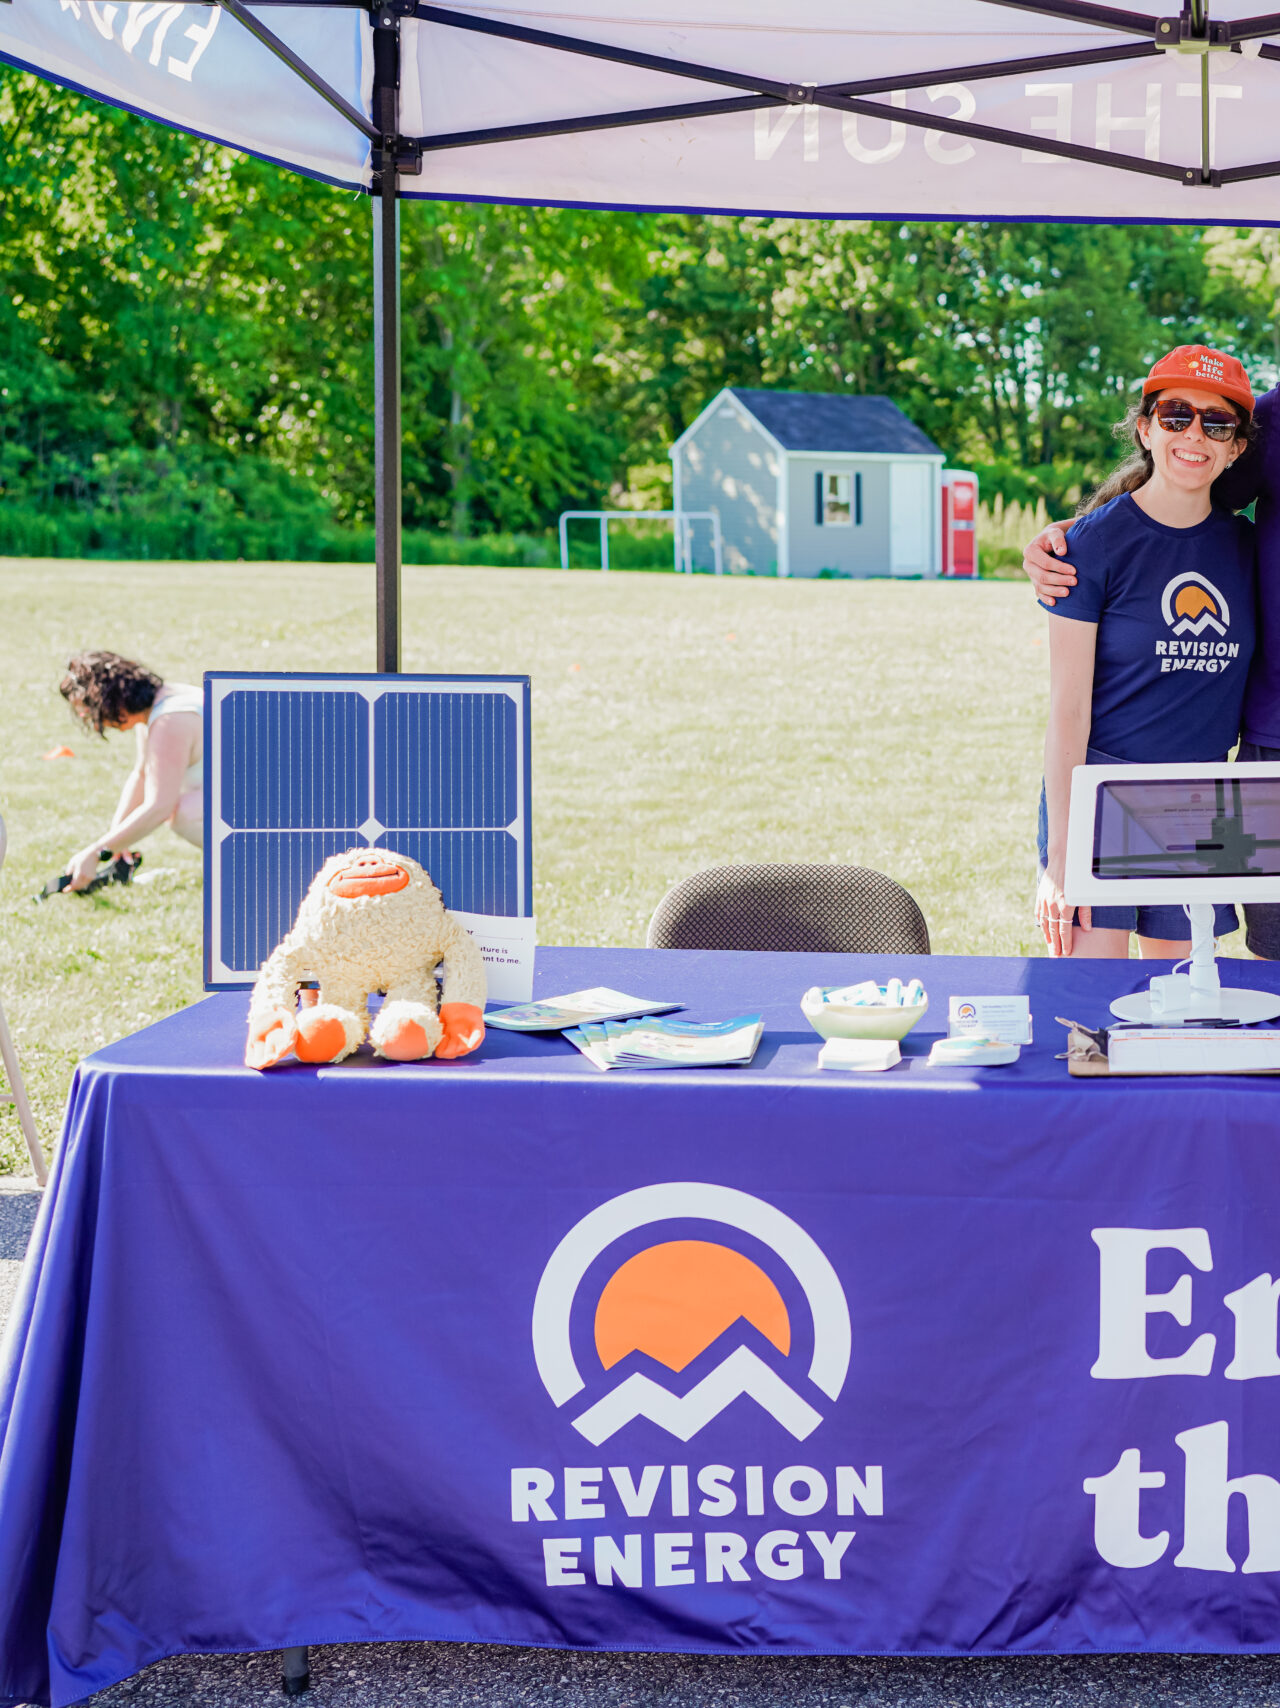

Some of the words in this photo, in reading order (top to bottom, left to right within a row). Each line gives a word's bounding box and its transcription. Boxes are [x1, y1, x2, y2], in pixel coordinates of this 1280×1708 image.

[1200, 354, 1224, 367] Make
[1195, 369, 1225, 383] better.
[1202, 363, 1223, 376] life
[1155, 640, 1240, 658] REVISION
[1161, 658, 1230, 673] ENERGY
[510, 1464, 884, 1522] REVISION
[542, 1529, 857, 1588] ENERGY
